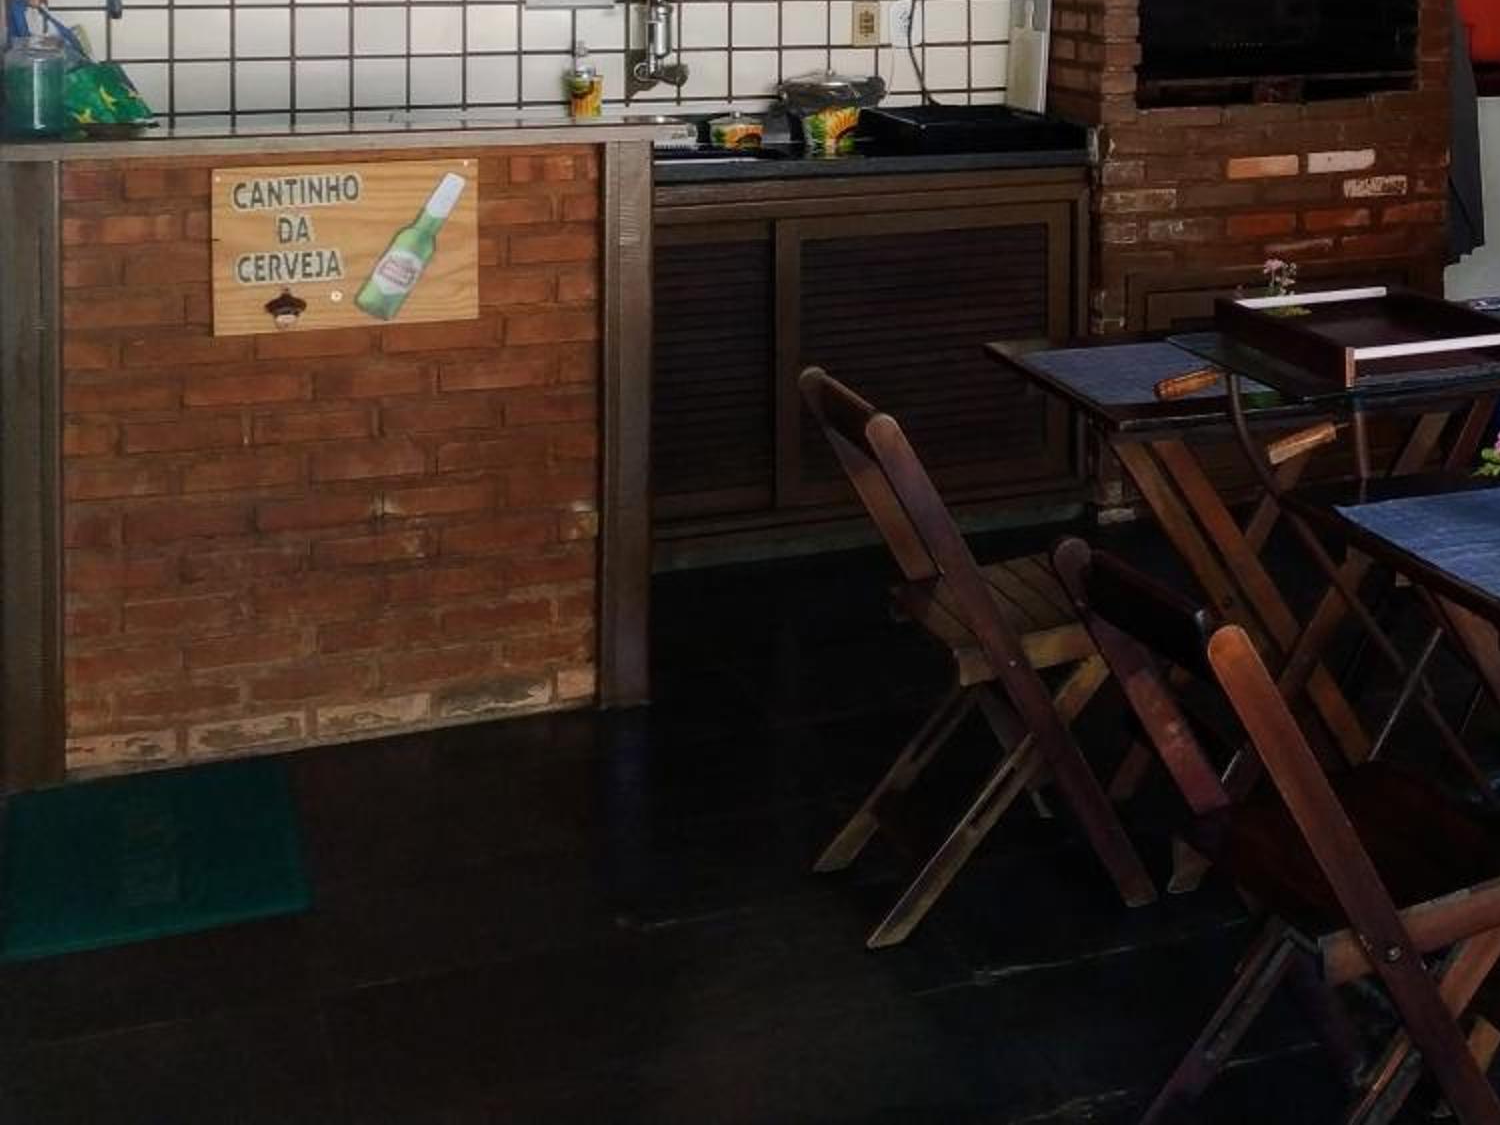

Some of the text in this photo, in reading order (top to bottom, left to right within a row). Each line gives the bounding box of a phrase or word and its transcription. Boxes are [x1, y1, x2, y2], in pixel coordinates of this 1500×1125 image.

[232, 174, 360, 210] CANTINHO
[276, 216, 312, 244] DA
[236, 250, 343, 283] CERVEJA
